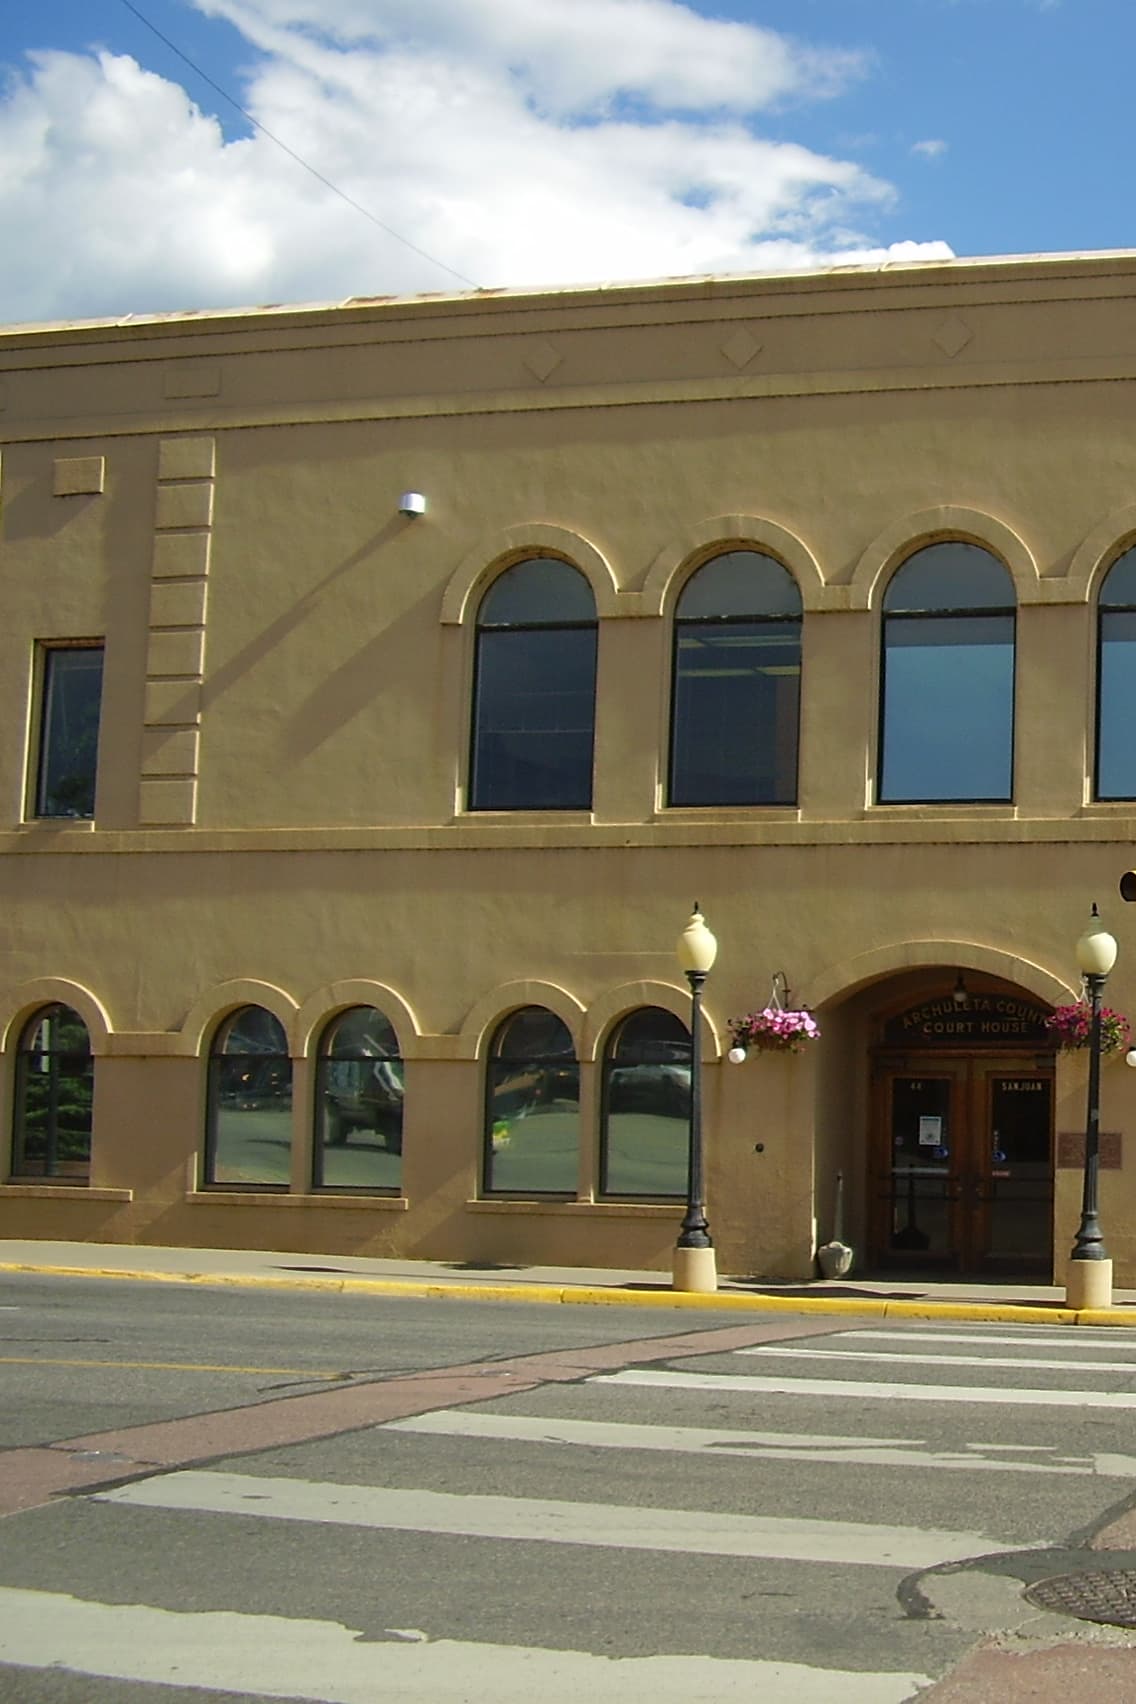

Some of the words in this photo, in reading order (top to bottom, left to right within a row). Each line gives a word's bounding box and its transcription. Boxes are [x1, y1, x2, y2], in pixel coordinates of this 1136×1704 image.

[904, 998, 992, 1030] ARCHULETA
[996, 1000, 1047, 1025] COUNT
[923, 1022, 973, 1033] COURT
[981, 1022, 1026, 1033] HOUSE
